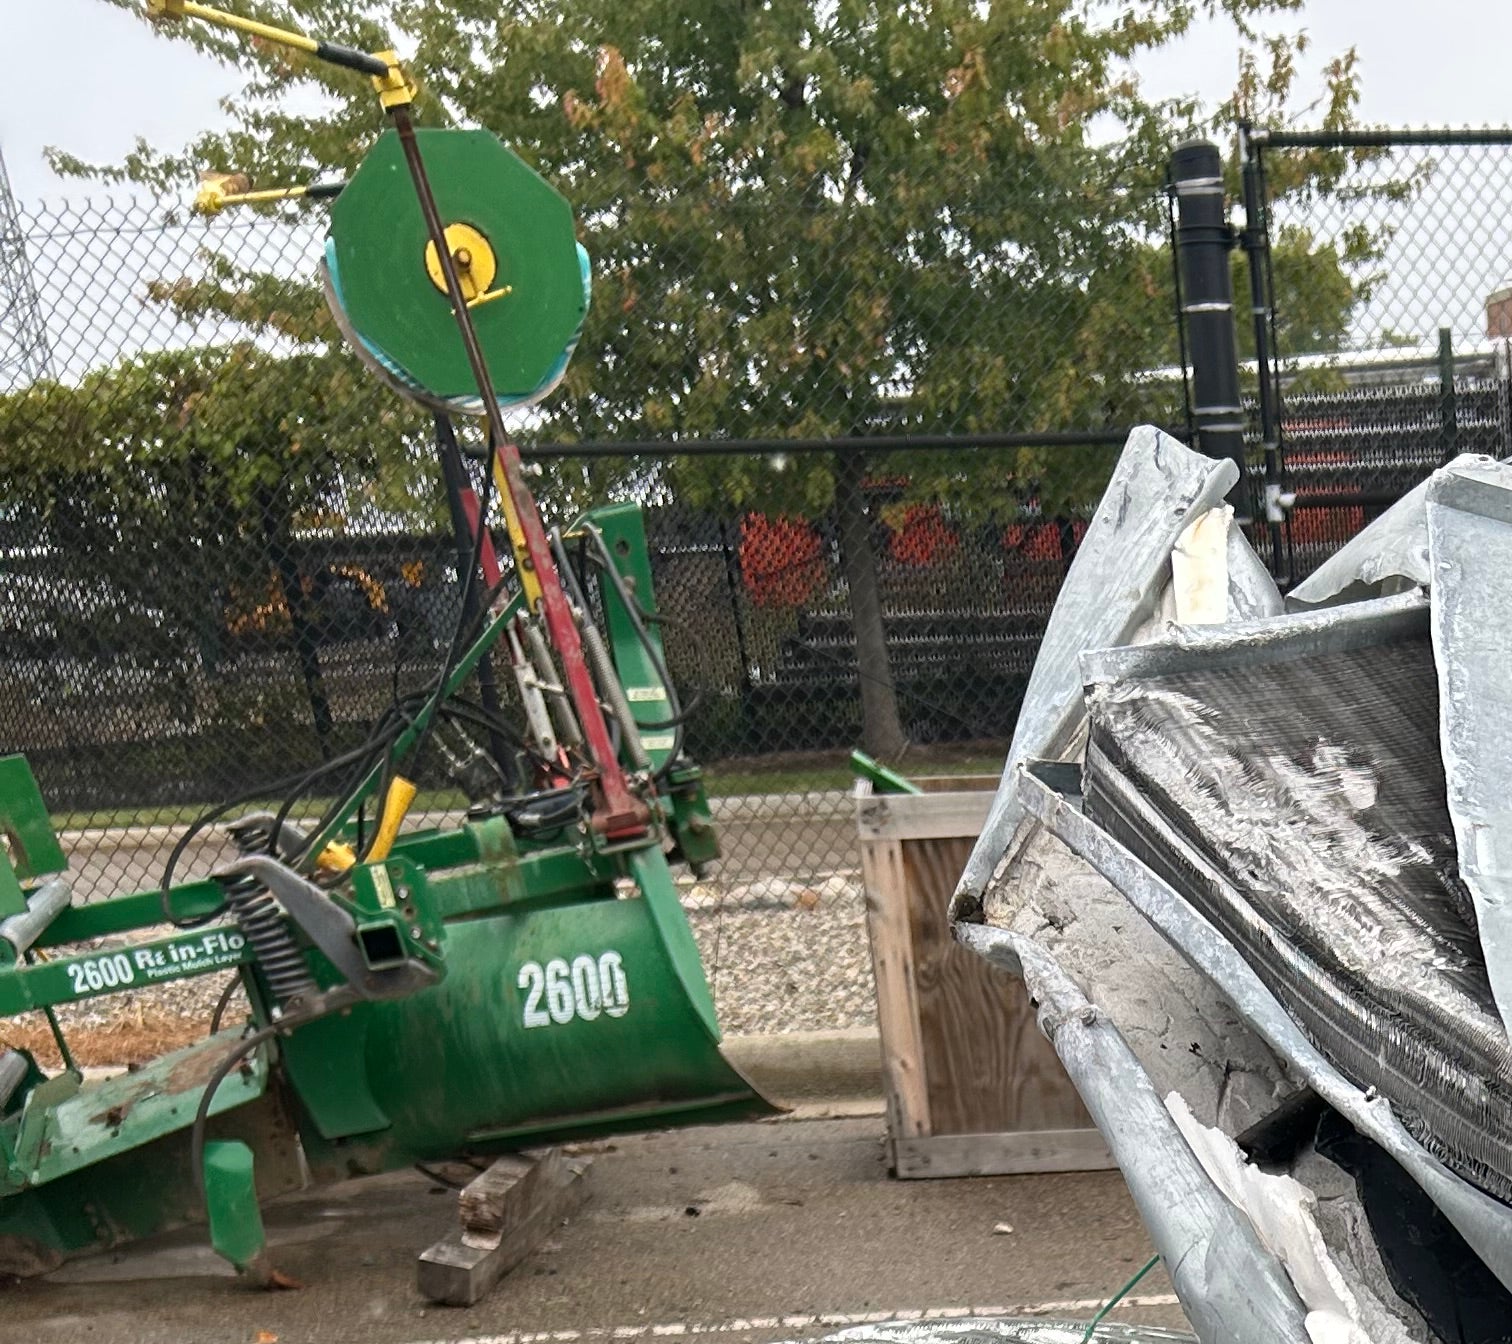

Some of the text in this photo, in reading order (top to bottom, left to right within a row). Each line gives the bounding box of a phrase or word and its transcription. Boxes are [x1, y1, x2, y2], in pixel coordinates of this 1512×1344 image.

[68, 953, 135, 994] 2600
[147, 951, 243, 979] Plastic Mulch Layer
[518, 950, 629, 1029] 2600
